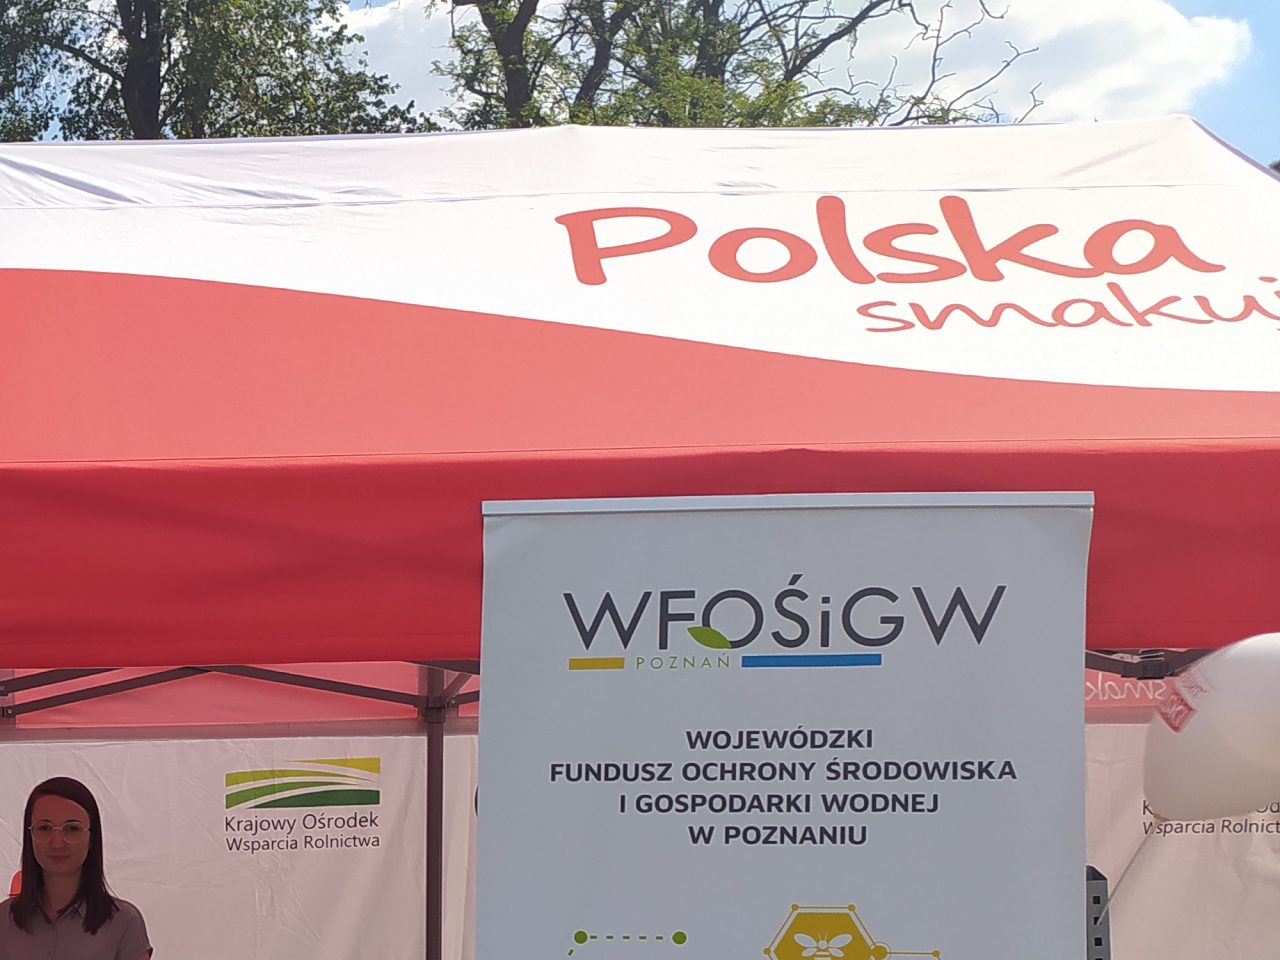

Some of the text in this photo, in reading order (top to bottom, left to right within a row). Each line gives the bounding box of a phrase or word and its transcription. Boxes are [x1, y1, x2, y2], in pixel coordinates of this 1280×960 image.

[554, 195, 1225, 285] Polska
[856, 277, 1280, 332] smaku
[563, 573, 1007, 652] WFOŚiGW
[635, 651, 731, 671] POZNAŃ
[686, 724, 874, 750] WOJEWÓDZKI
[550, 756, 1017, 783] FUNDUSZ OCHRONY ŚRODOWISKA
[619, 792, 940, 815] I GOSPODARKI WODNEJ
[224, 810, 380, 836] Krajowy Ośrodek
[687, 824, 868, 846] W POZNANIU
[1221, 819, 1280, 834] Rolnict
[225, 833, 381, 854] Wsparcia Rolnictwa
